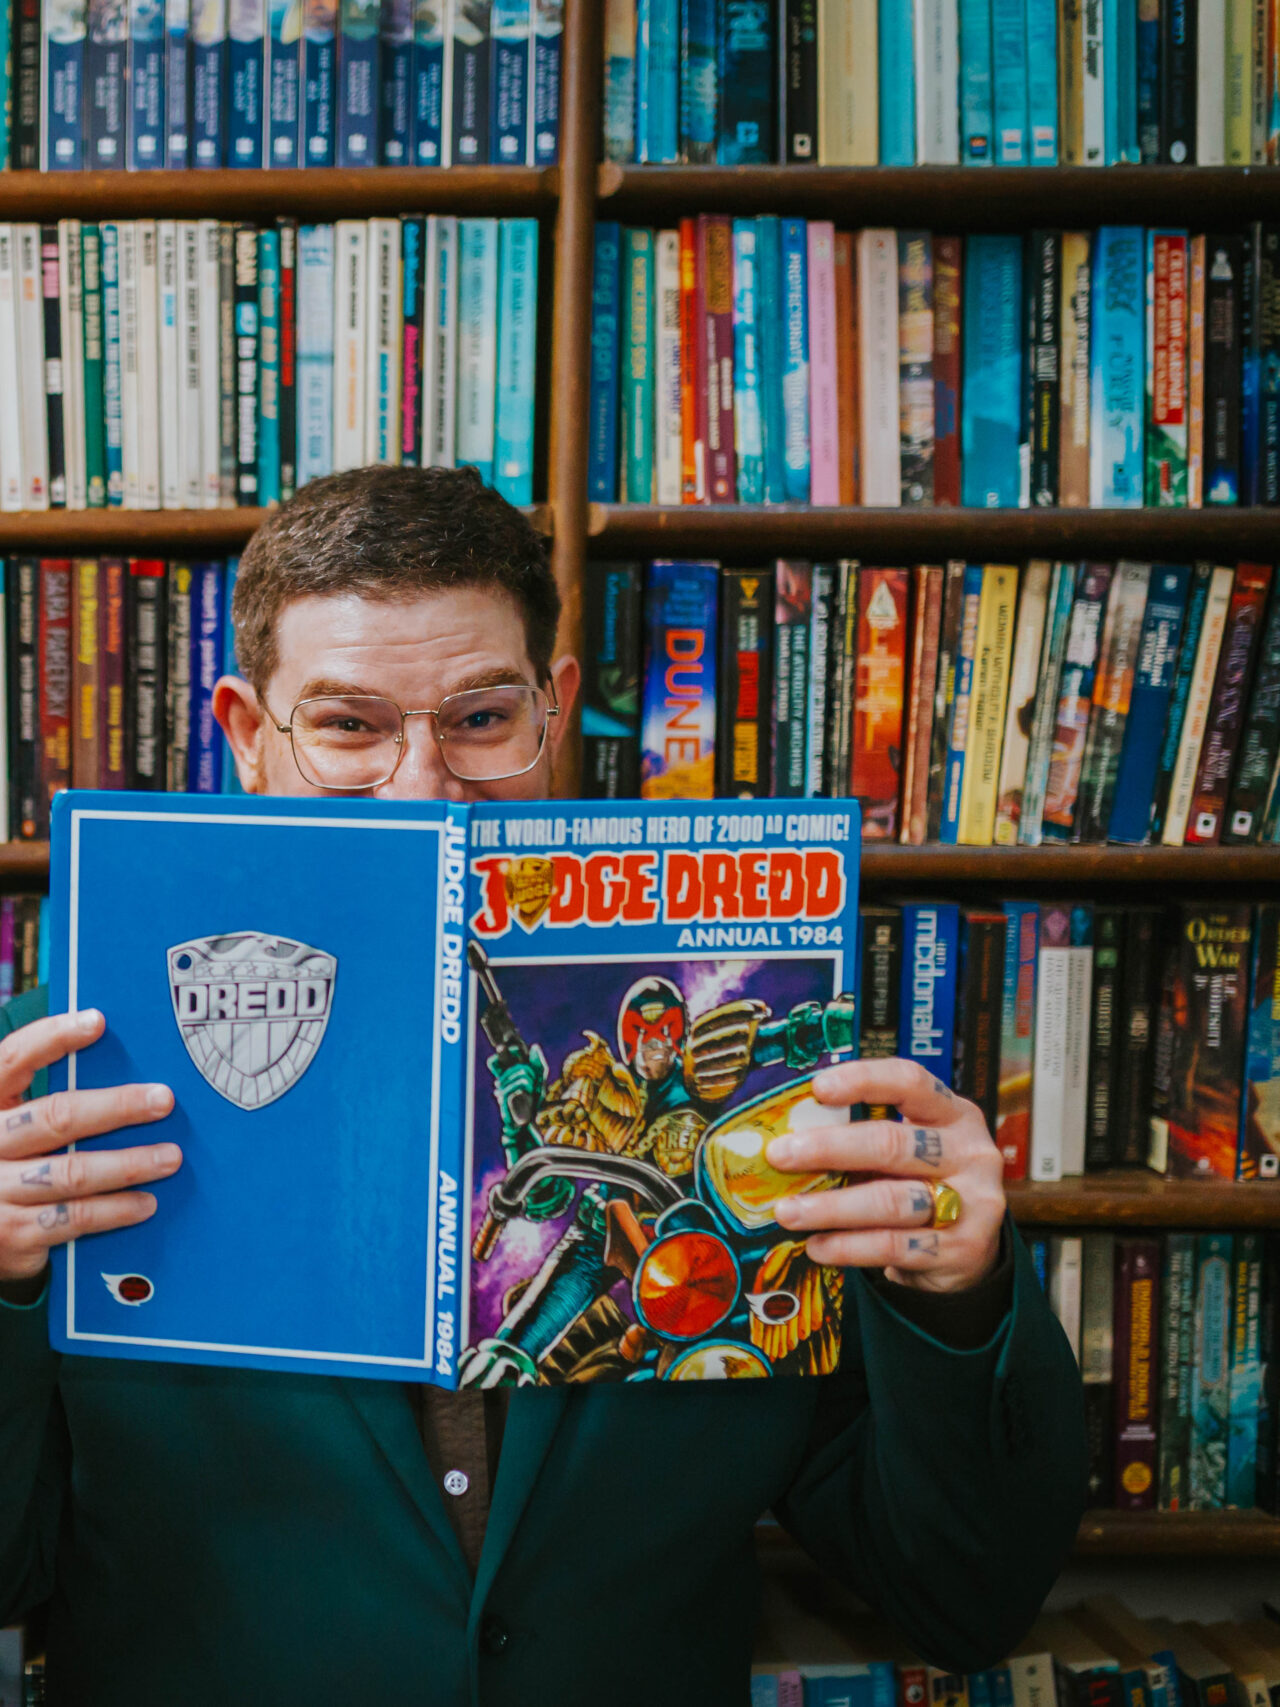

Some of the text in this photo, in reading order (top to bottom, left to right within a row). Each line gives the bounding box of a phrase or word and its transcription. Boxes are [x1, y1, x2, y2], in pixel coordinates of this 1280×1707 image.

[239, 360, 256, 393] Who
[593, 314, 616, 381] Egan
[1169, 339, 1182, 410] GARDNER
[239, 395, 256, 464] Hesitates
[78, 564, 98, 665] Sara Paretsky
[107, 597, 120, 654] Paretsky
[202, 571, 217, 619] robert
[45, 571, 68, 718] SARA PARETSKY
[200, 639, 217, 690] parker
[779, 625, 791, 678] CHARLES
[664, 629, 705, 764] DUNE
[789, 625, 805, 786] THE ATROCITY ARCHIVES
[471, 814, 850, 847] THE WORLD-FAMOUS HERO OF 2000 AD COMIC!
[662, 848, 846, 924] DREDD
[677, 926, 843, 947] ANNUAL 1984
[179, 980, 328, 1020] DREDD
[911, 910, 945, 1056] mcdonald
[435, 815, 467, 1378] JUDGE DREDD ANNUAL 1984
